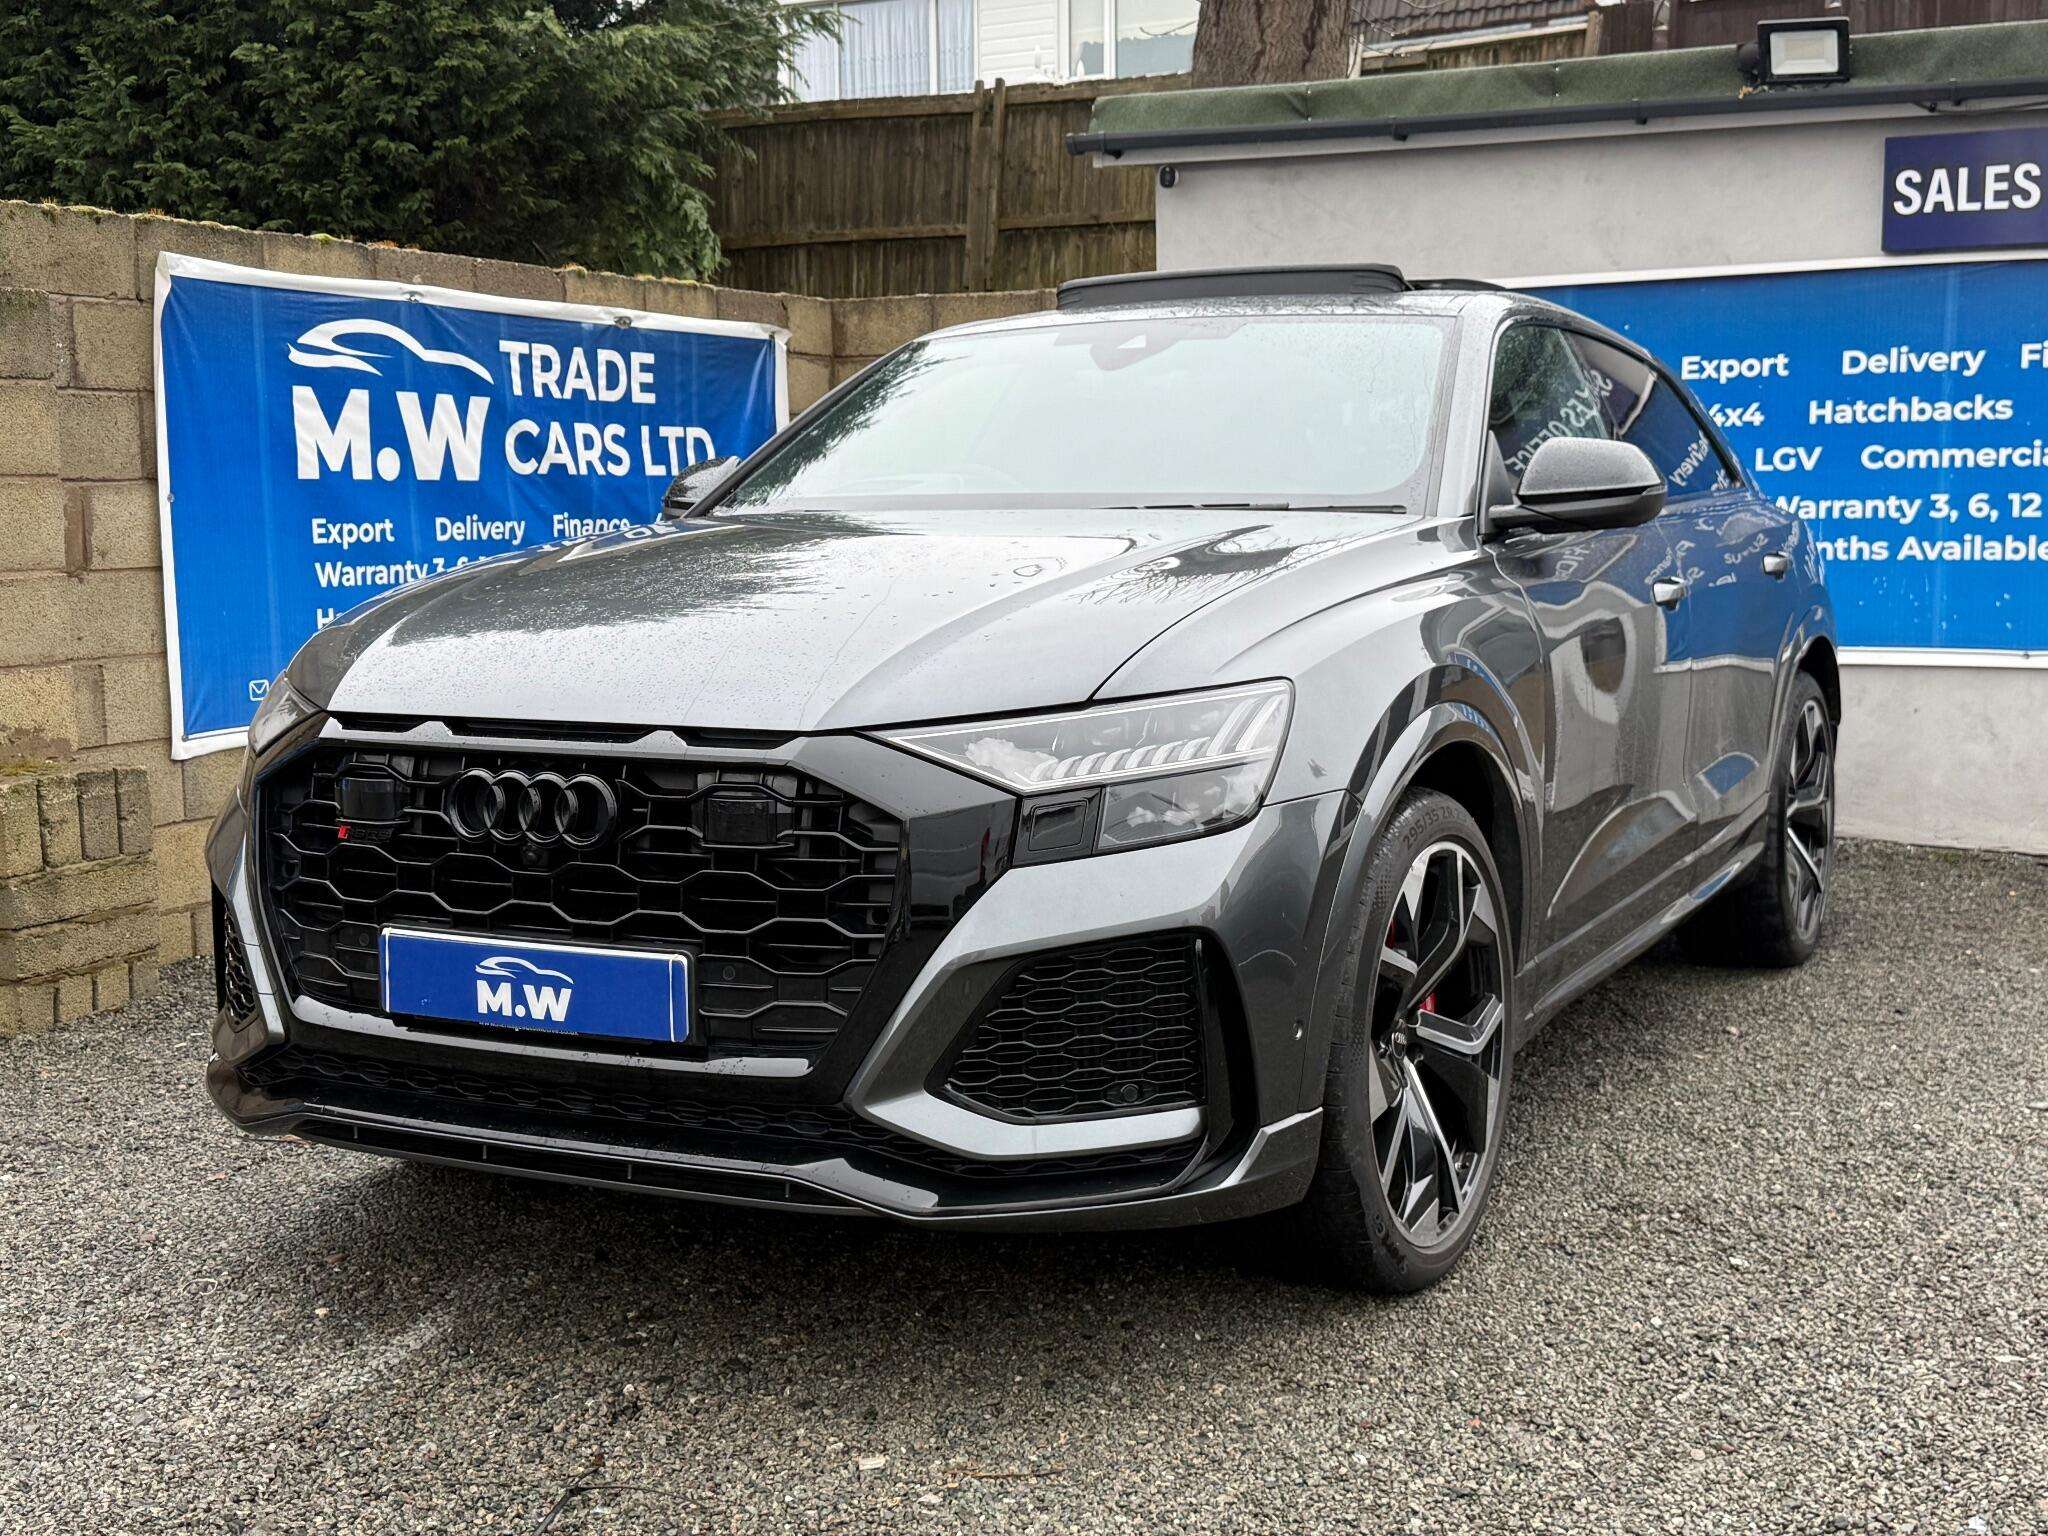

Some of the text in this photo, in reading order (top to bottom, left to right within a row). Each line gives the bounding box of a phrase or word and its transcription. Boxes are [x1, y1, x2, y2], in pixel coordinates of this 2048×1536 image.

[1893, 162, 2041, 215] SALES
[499, 340, 656, 403] TRADE
[1681, 353, 1790, 384] Export
[1842, 345, 1987, 377] Delivery
[1709, 394, 2014, 427] 4x4 Hatchbacks
[292, 385, 490, 481] M.W
[505, 418, 716, 476] CARS LTD
[1755, 446, 1823, 471] LGV
[1929, 493, 1959, 523] 3,
[1968, 492, 1998, 523] 6,
[2008, 492, 2042, 518] 12
[312, 518, 395, 550] Export
[435, 514, 525, 545] Delivery
[1815, 535, 1890, 561] nths
[314, 560, 429, 588] Warranty
[477, 980, 572, 1021] M.W
